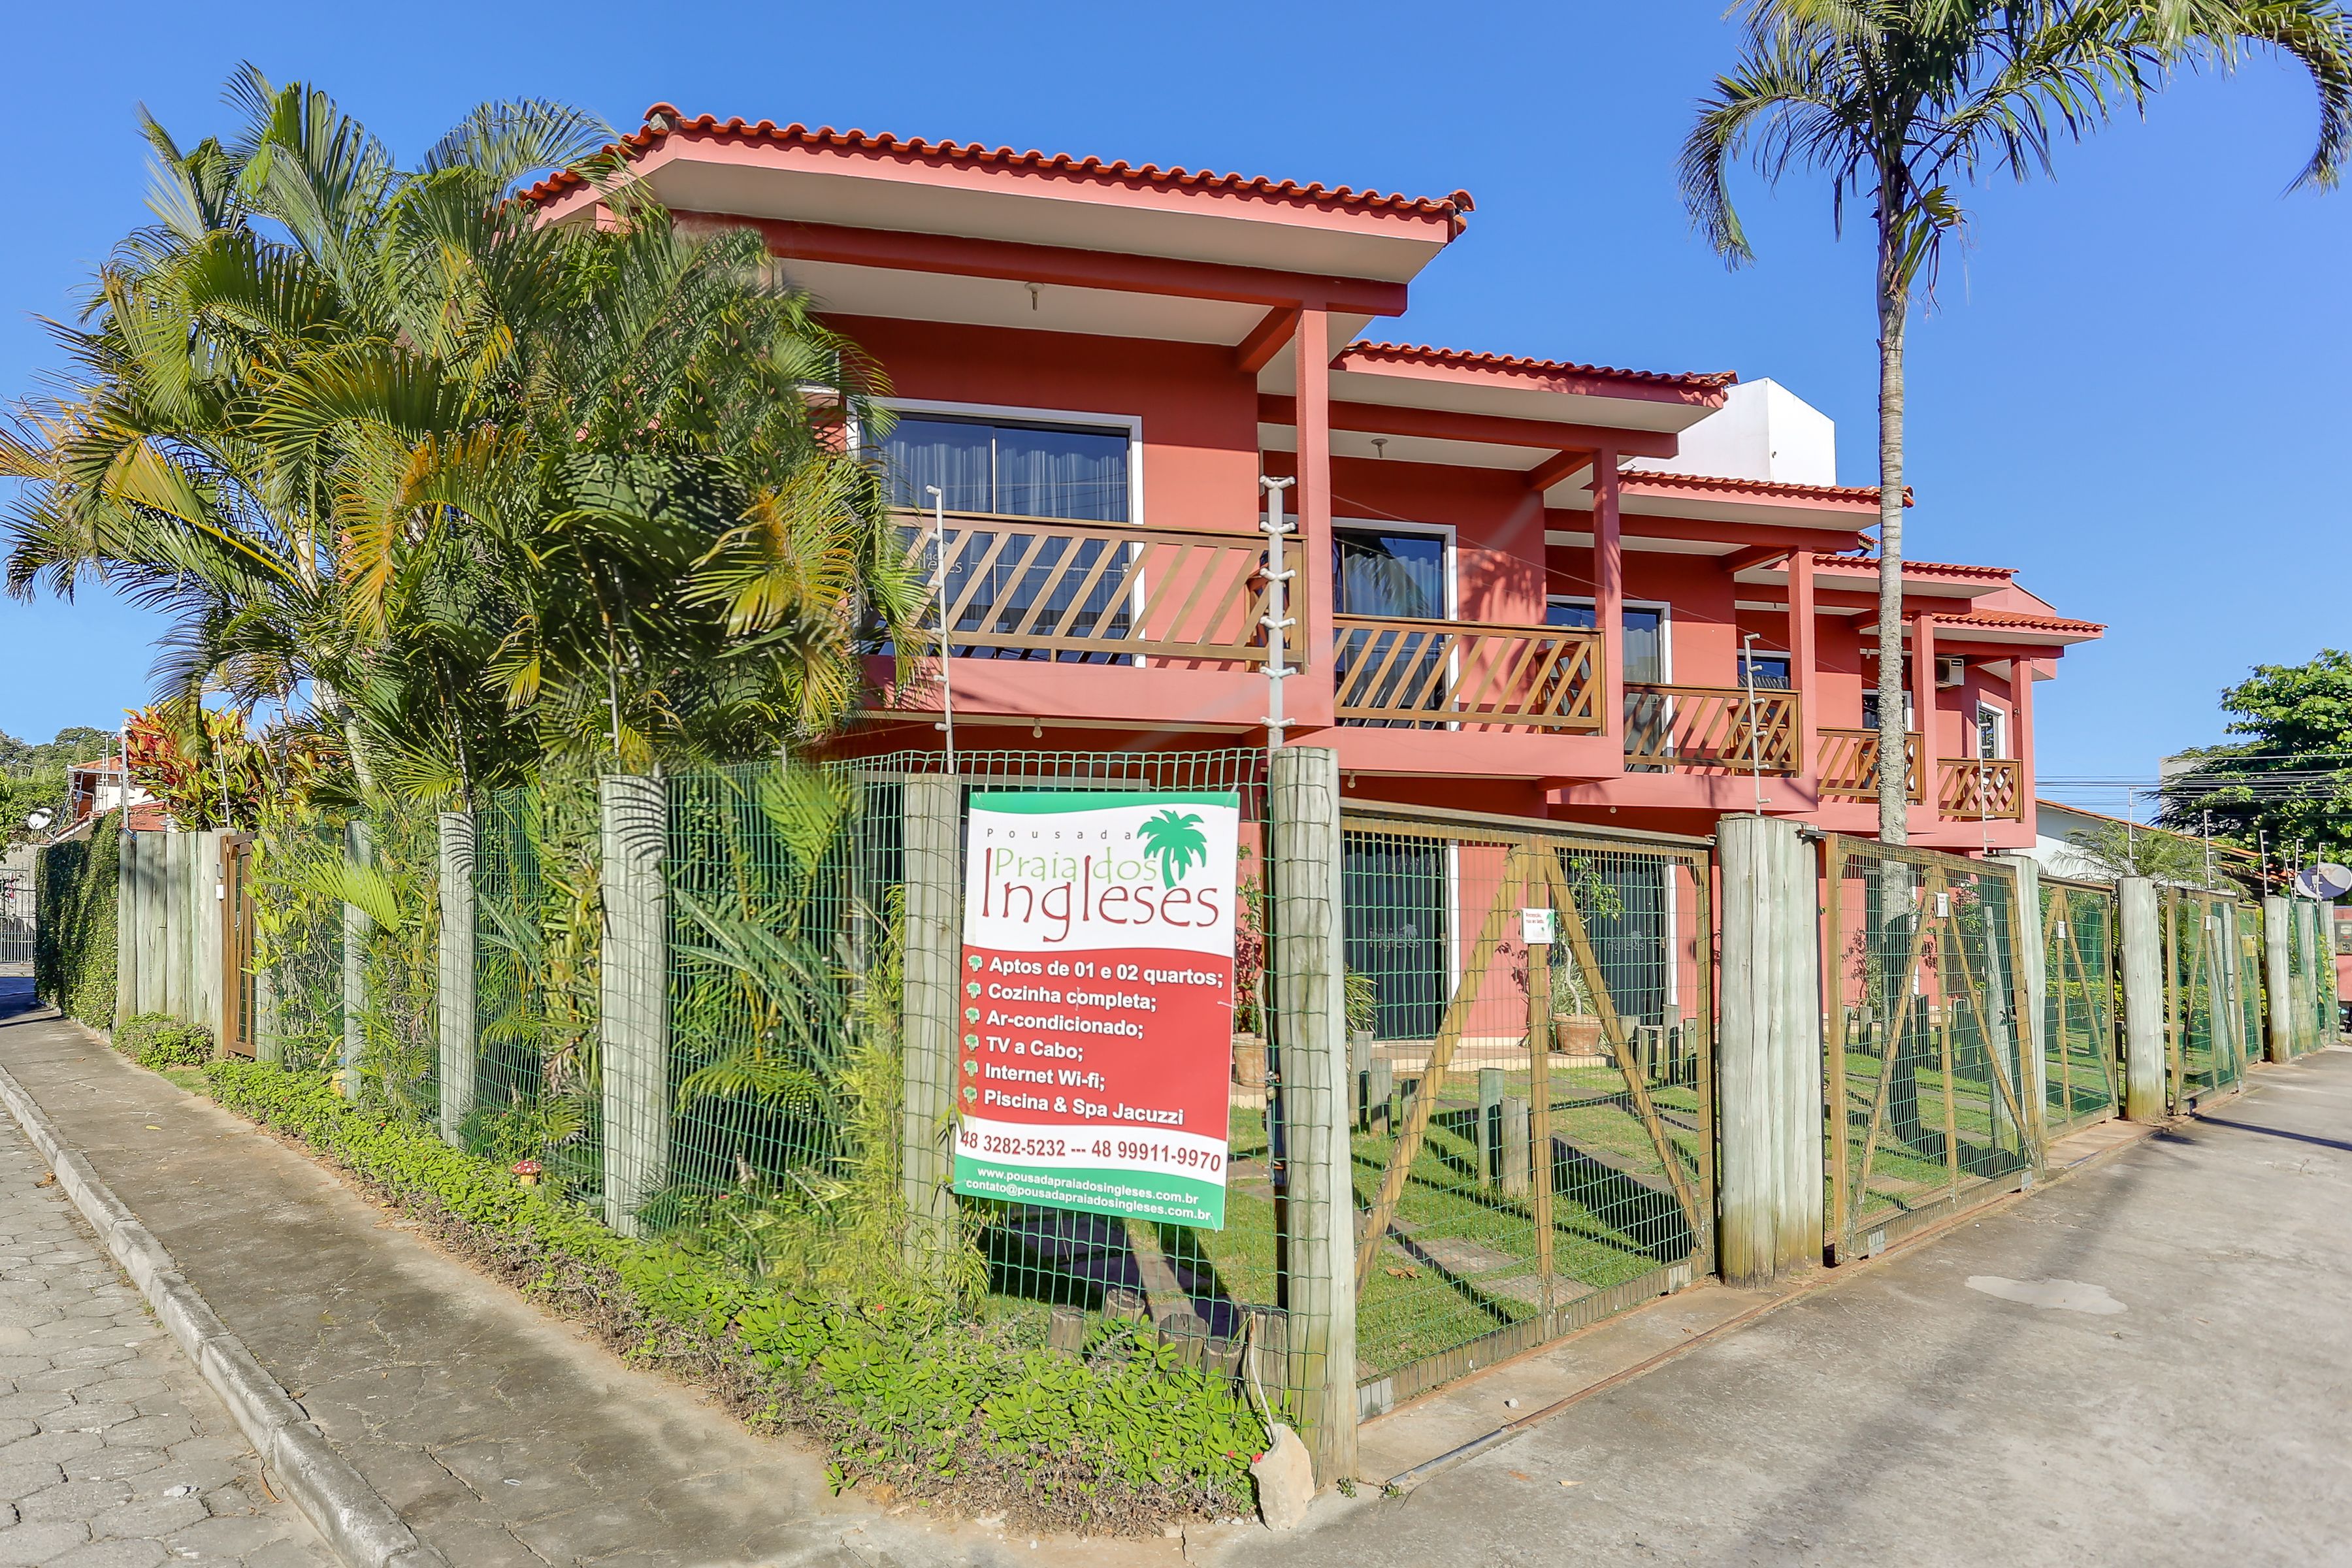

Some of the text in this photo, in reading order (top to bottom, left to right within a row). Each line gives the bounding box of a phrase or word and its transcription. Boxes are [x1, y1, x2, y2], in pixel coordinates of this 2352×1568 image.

[987, 827, 1132, 840] Pousada
[994, 846, 1157, 884] Praia dos
[982, 847, 1220, 943] Ingleses
[988, 956, 1224, 988] Aptos de 01 e 02 quartos;
[988, 983, 1157, 1012] Cozinha completa;
[986, 1009, 1144, 1039] Ar-condicionado;
[985, 1036, 1084, 1062] TV a Cabo;
[985, 1062, 1105, 1091] Internet Wi-fi;
[984, 1089, 1184, 1125] Piscina & Spa Jacuzzi
[960, 1131, 979, 1150] 48
[983, 1135, 1066, 1156] 3282-5232
[1091, 1140, 1111, 1157] 48
[1117, 1141, 1221, 1173] 99911-9970
[965, 1179, 1212, 1221] contato@pousadapraiadosingleses.com.br
[977, 1168, 1200, 1205] www.pousadapraiadosingleses.com.br
